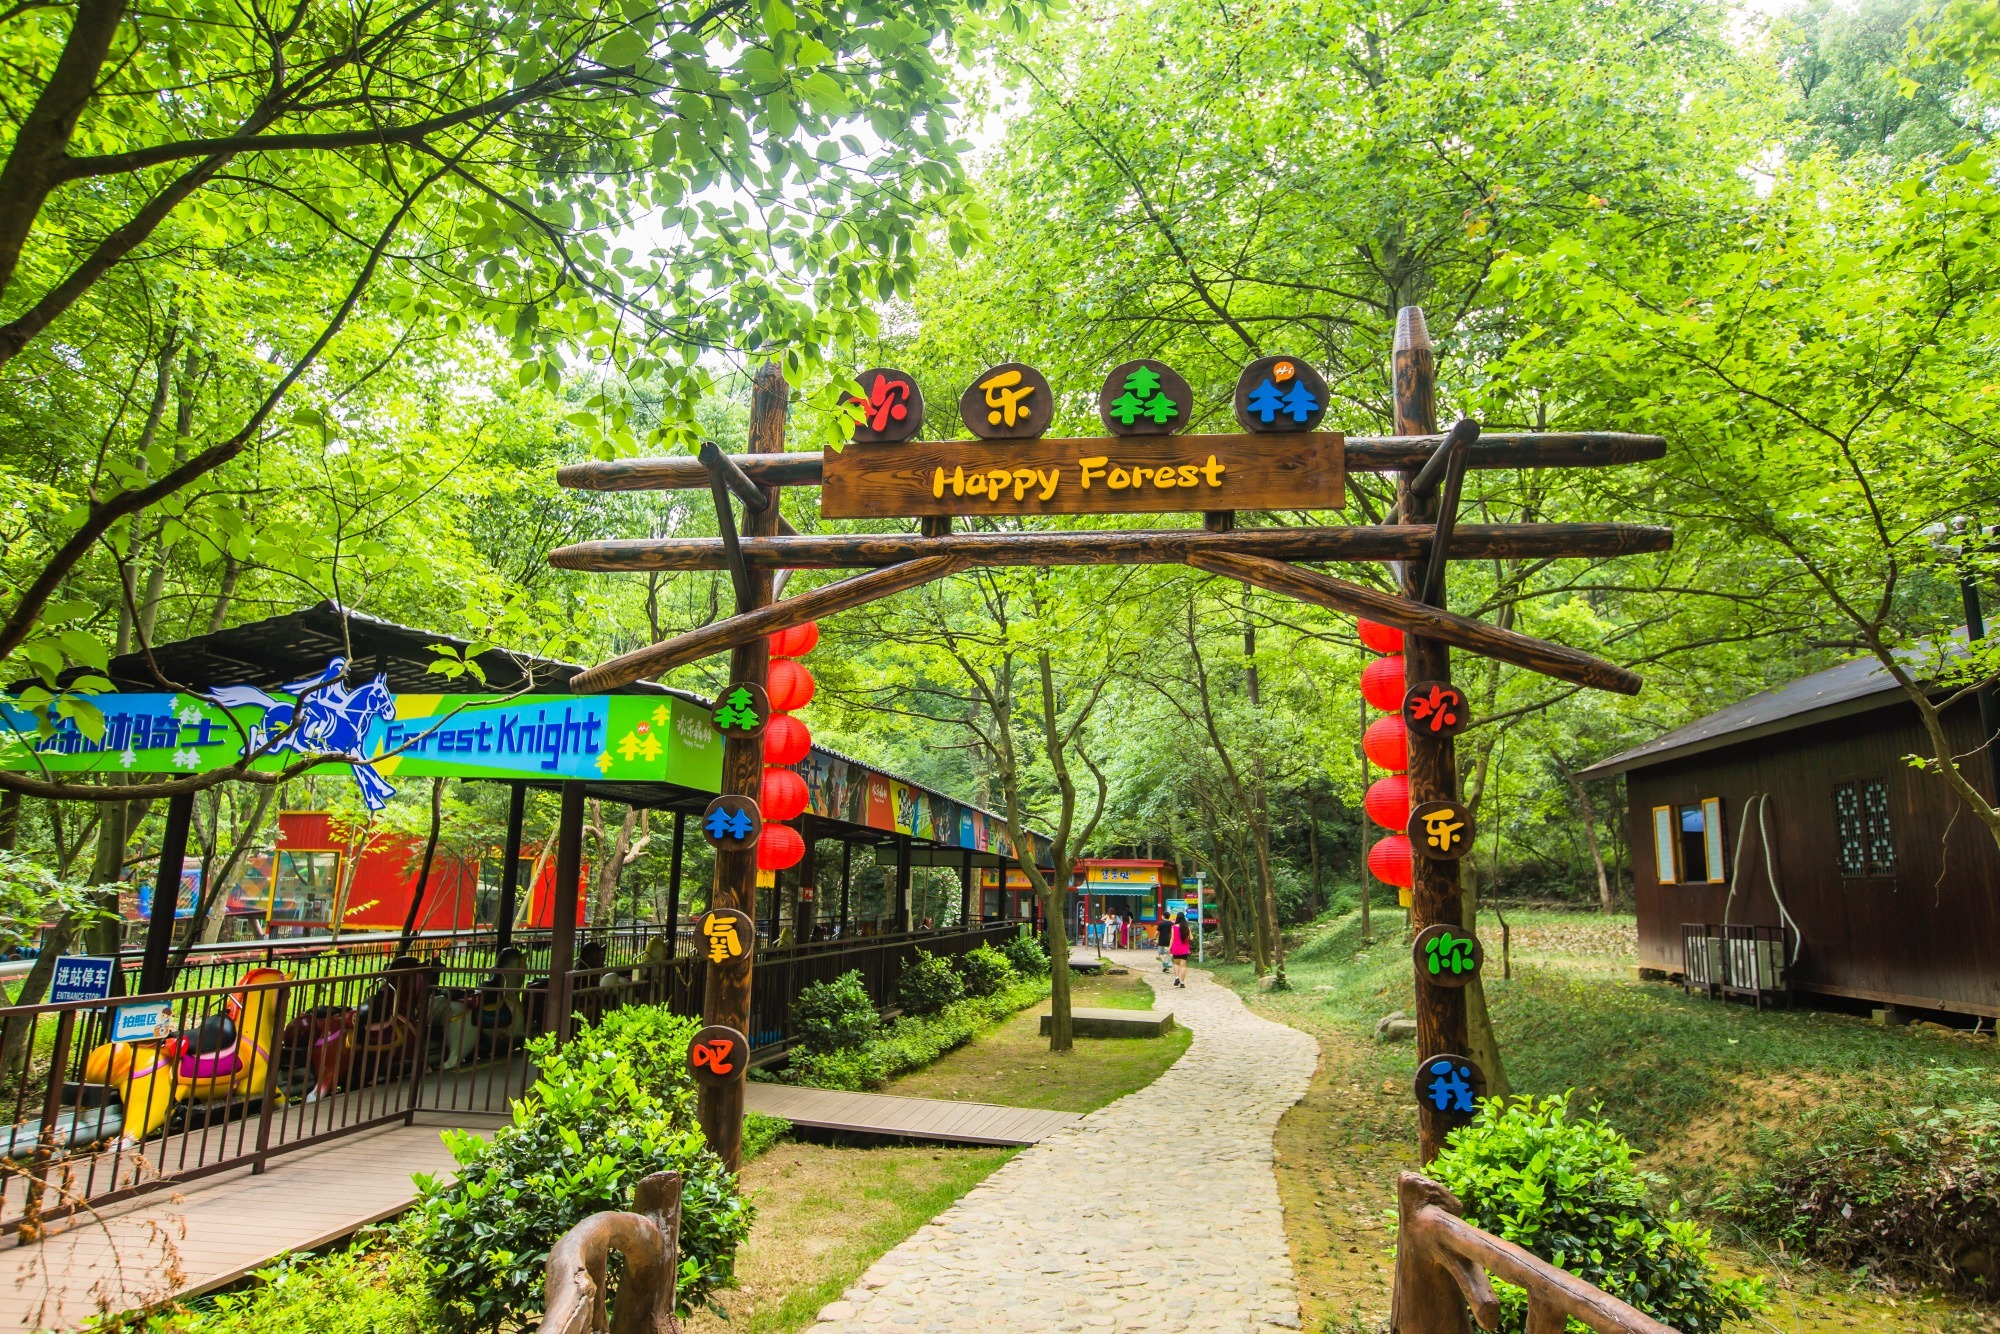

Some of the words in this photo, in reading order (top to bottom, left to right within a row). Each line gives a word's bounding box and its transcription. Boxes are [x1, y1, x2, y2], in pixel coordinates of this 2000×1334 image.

[979, 370, 1036, 428] 乐
[932, 464, 1061, 502] Happy
[1078, 453, 1226, 491] Forest
[1409, 685, 1459, 732] 欢
[384, 720, 494, 753] Forest
[496, 706, 602, 771] Knight
[1421, 808, 1465, 852] 乐
[703, 913, 743, 964] 氧
[1425, 932, 1475, 975] 你
[56, 966, 107, 988] 进站停车
[56, 991, 84, 1001] ENTRANCE
[122, 1013, 158, 1029] 拍照区
[692, 1039, 734, 1075] 吧
[1428, 1060, 1474, 1112] 我
